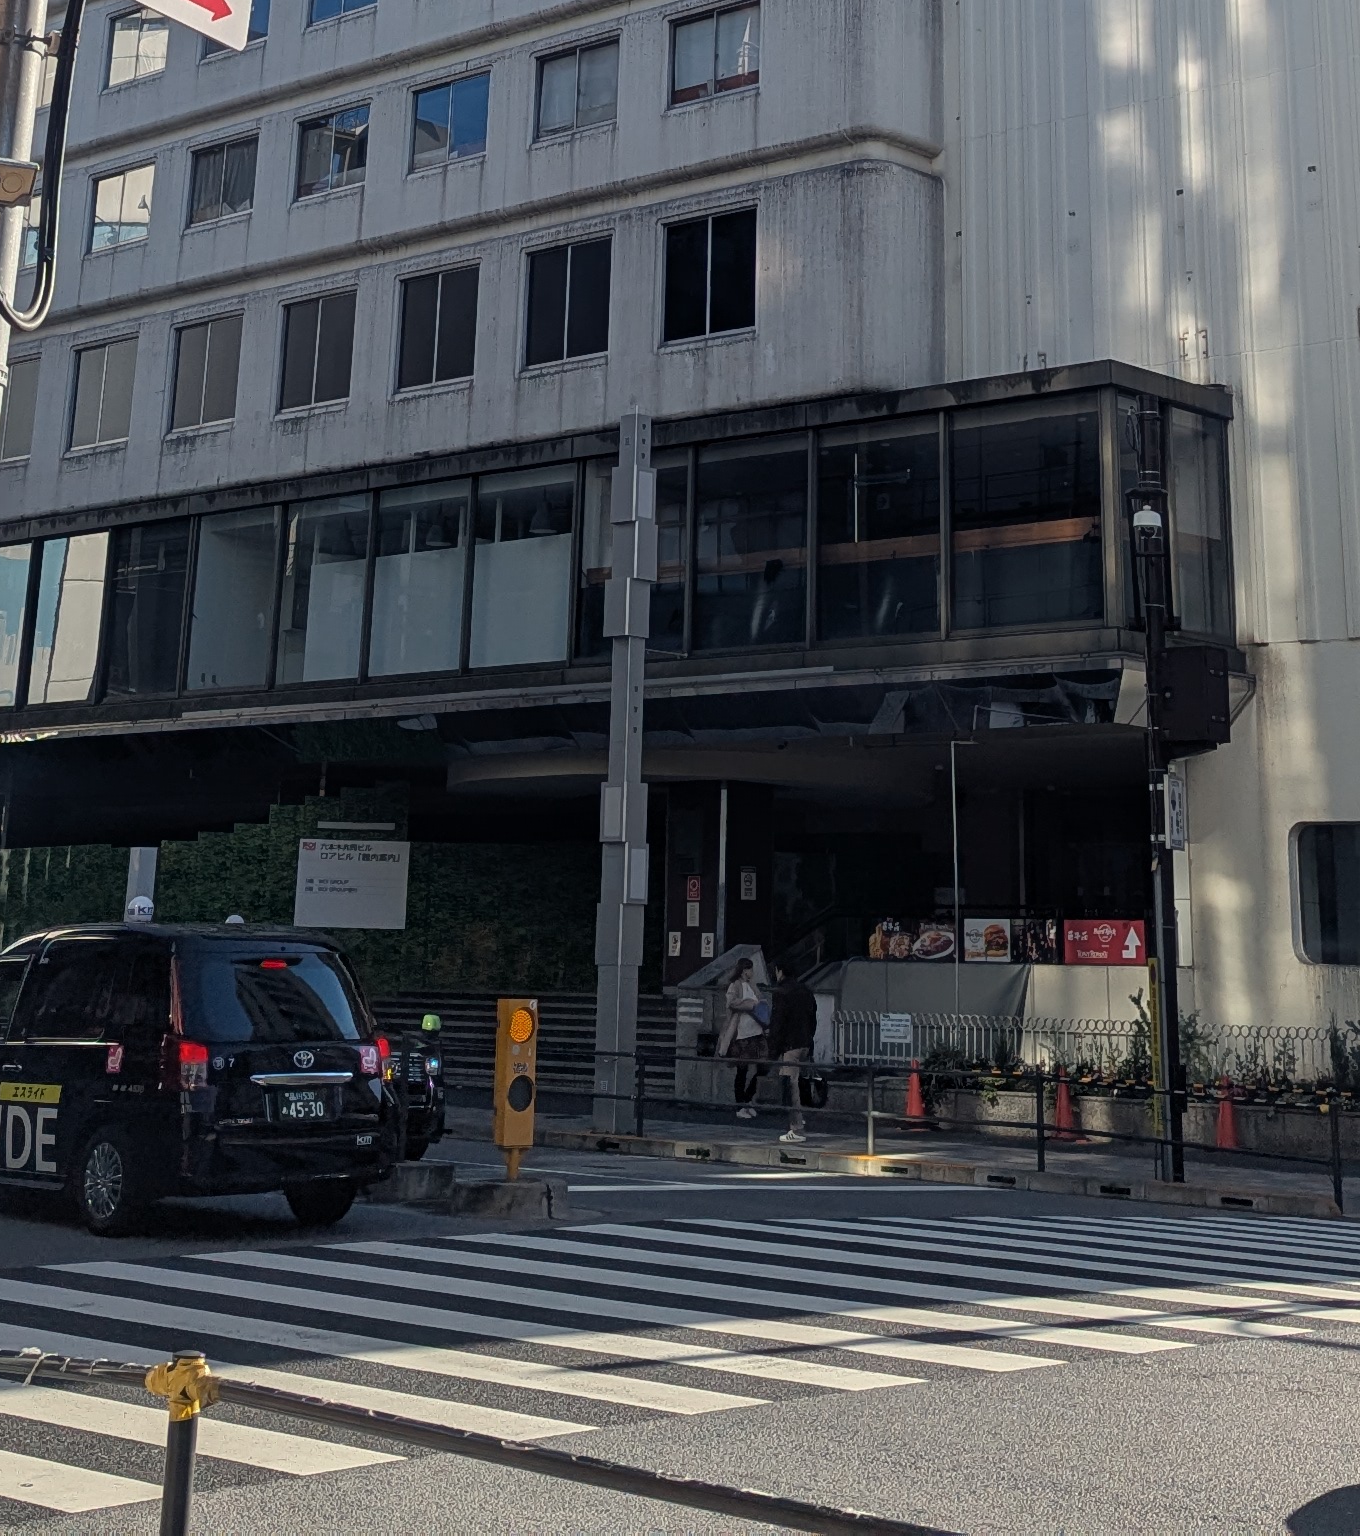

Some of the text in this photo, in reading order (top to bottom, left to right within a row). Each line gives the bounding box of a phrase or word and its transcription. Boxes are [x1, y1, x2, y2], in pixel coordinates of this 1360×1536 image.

[12, 1086, 47, 1099] エスライド
[290, 1101, 324, 1118] 45-30
